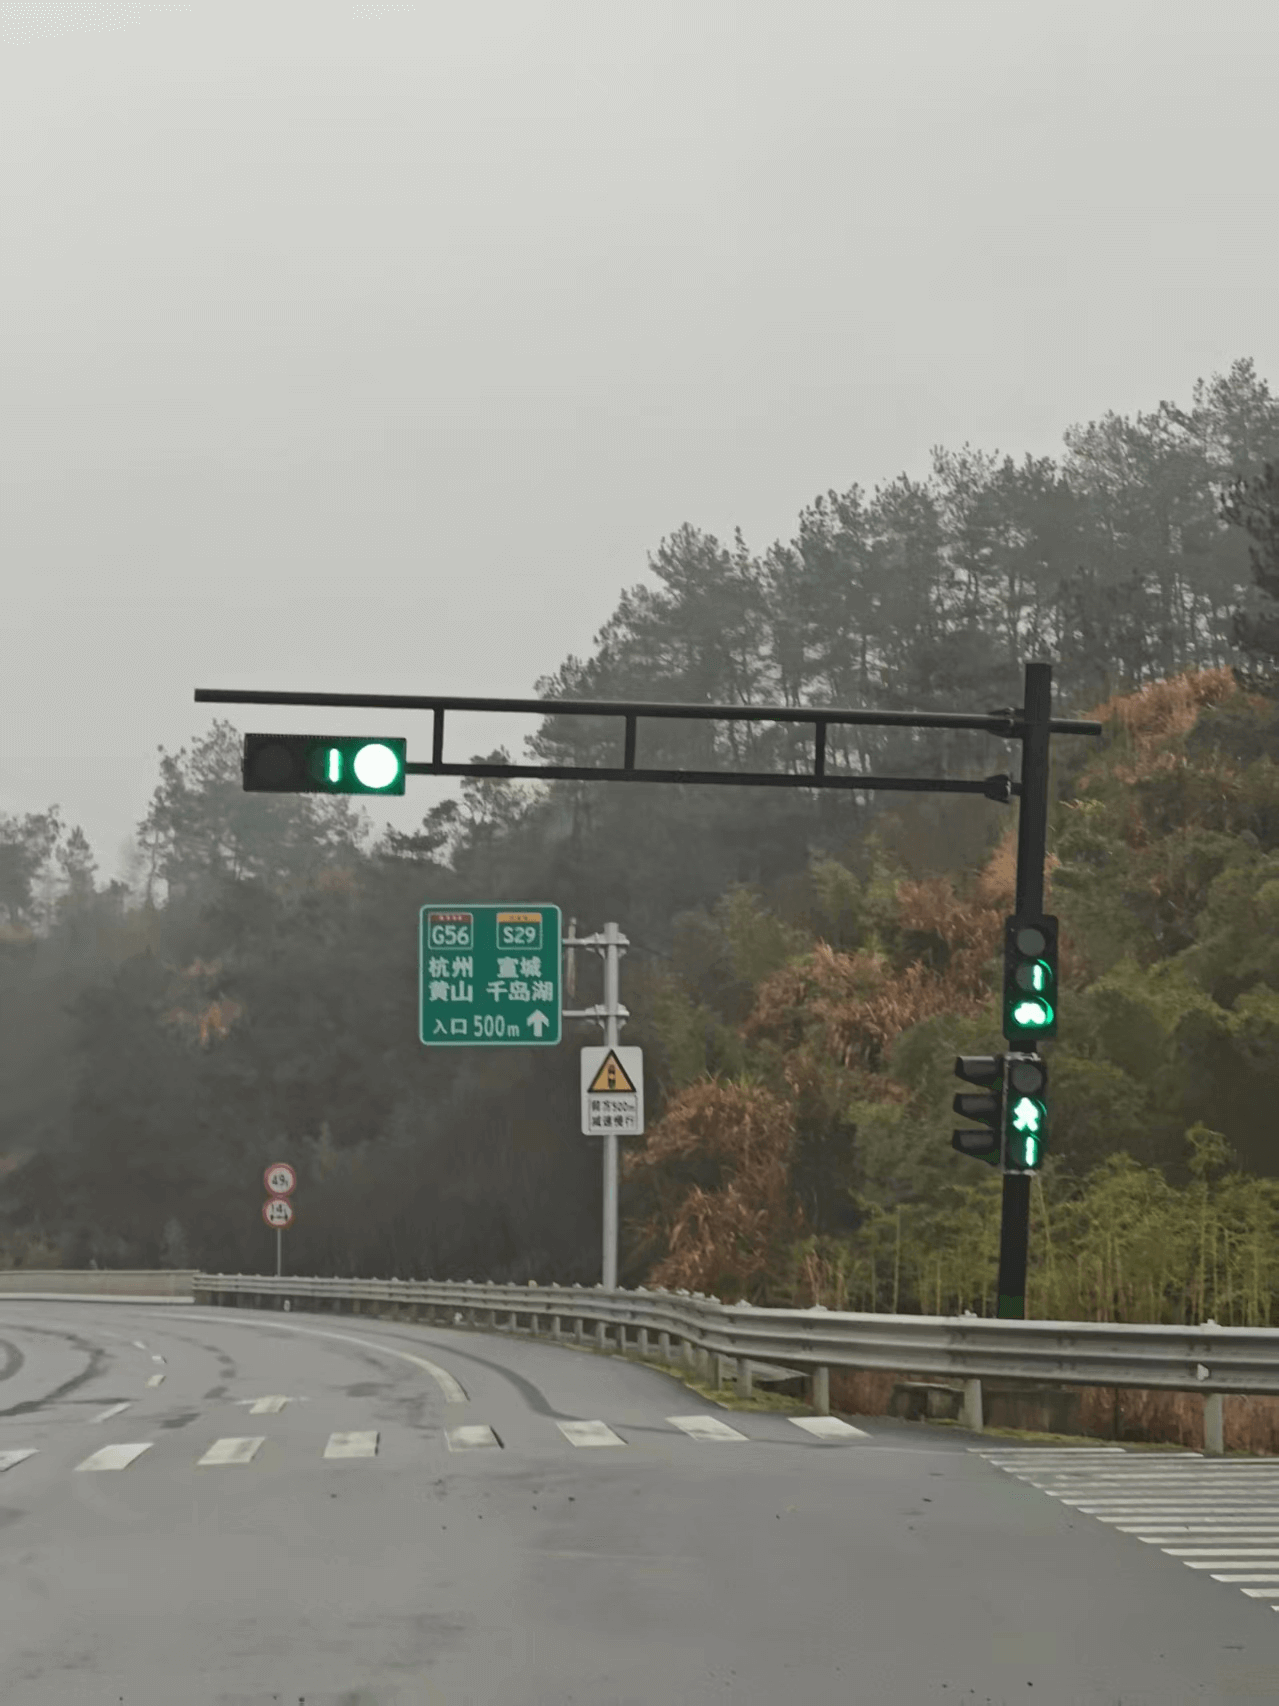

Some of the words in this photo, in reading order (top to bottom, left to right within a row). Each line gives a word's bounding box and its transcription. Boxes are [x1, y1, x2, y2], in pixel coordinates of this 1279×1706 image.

[432, 925, 470, 945] G56
[503, 926, 536, 944] S29
[428, 955, 473, 978] 杭州
[428, 980, 473, 1002] 黄山
[486, 980, 553, 1002] 千岛湖
[433, 1018, 467, 1035] 入口
[473, 1015, 520, 1037] 500m
